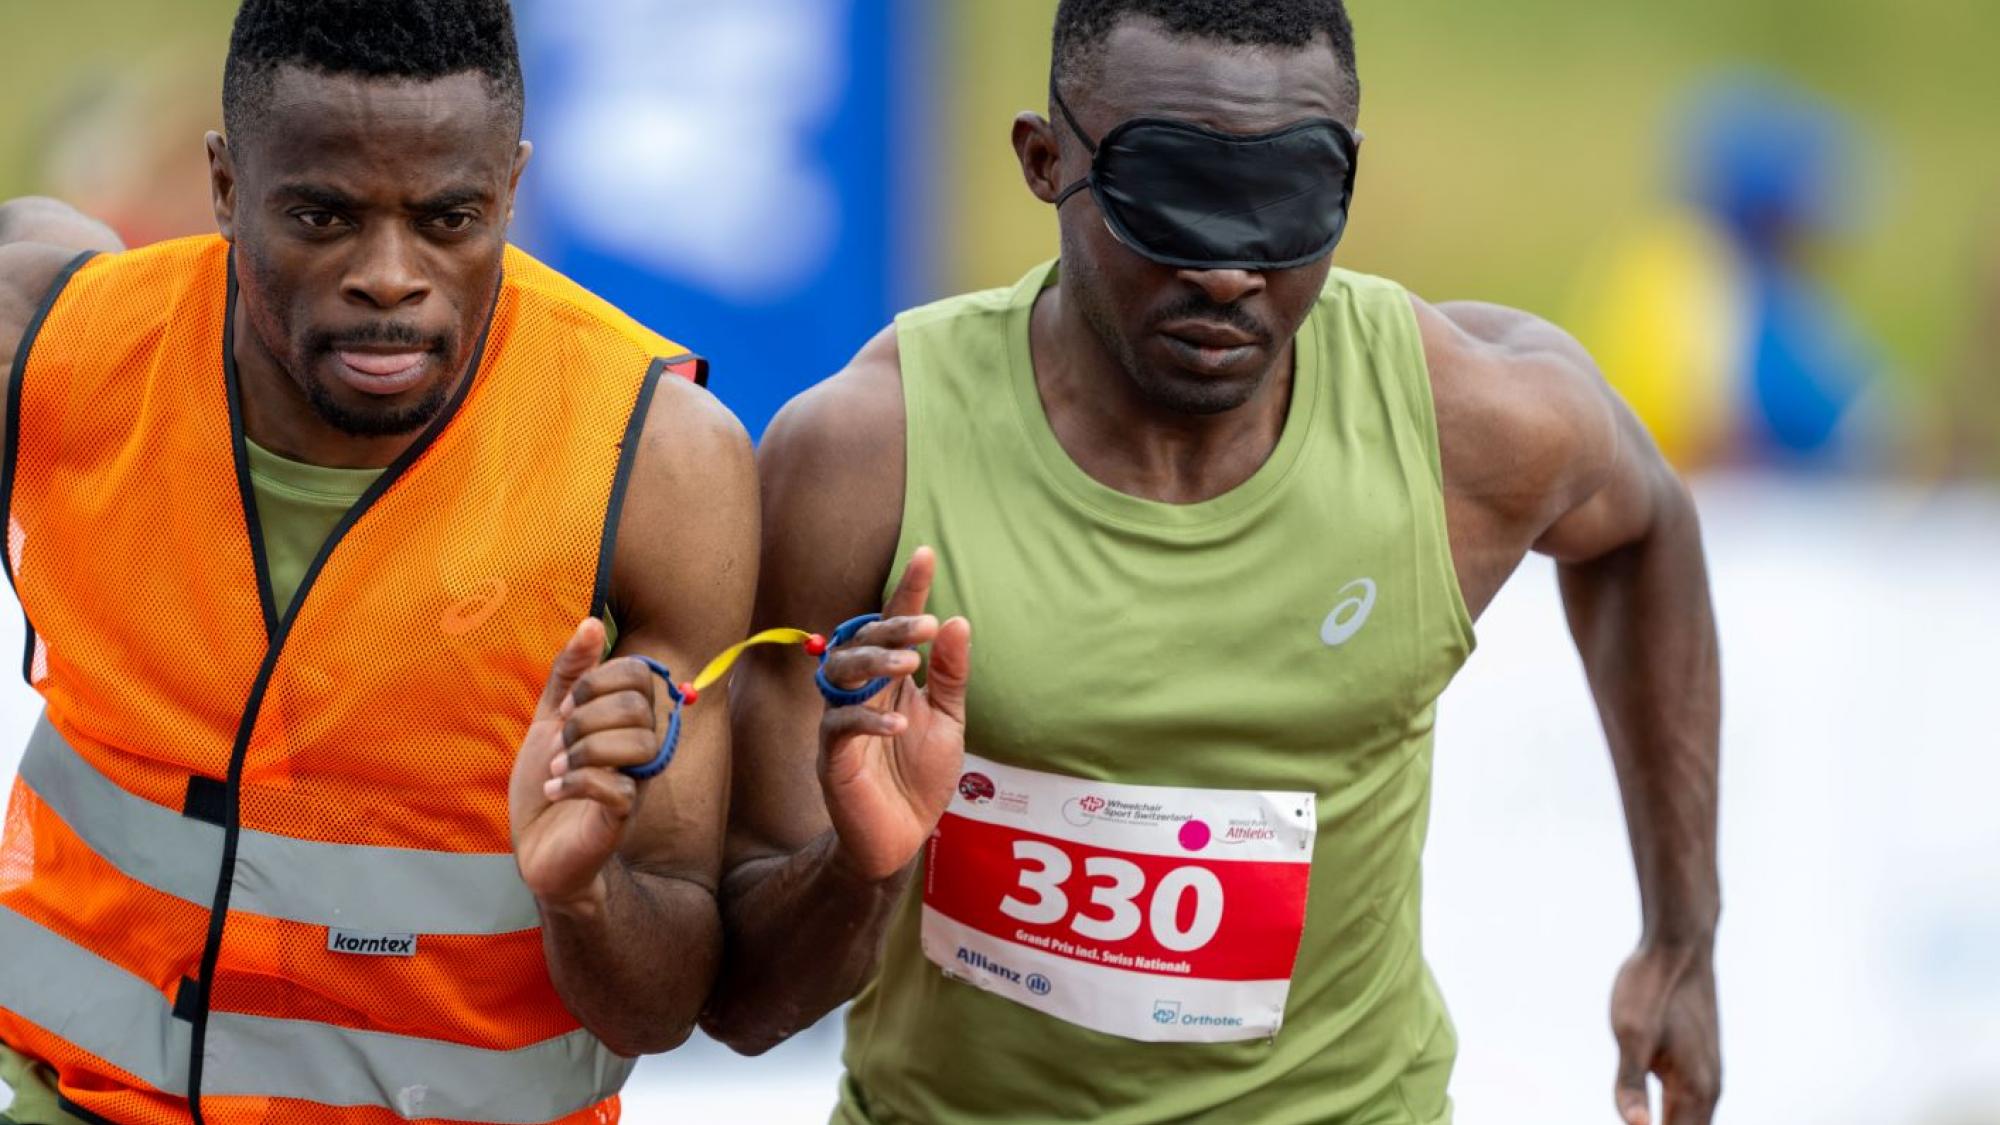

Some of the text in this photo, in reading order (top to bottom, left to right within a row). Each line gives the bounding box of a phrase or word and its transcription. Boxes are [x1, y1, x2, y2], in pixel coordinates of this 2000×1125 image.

[1104, 806, 1193, 821] Sport Switzerland
[1107, 799, 1163, 812] Wheelchair
[1225, 826, 1275, 840] Athletics
[999, 839, 1225, 952] 330
[334, 932, 412, 953] korntex
[1015, 929, 1192, 974] Grand Prix incl. Swiss Nationals
[956, 946, 1021, 985] Allianz
[1182, 1013, 1244, 1027] Orthotec
